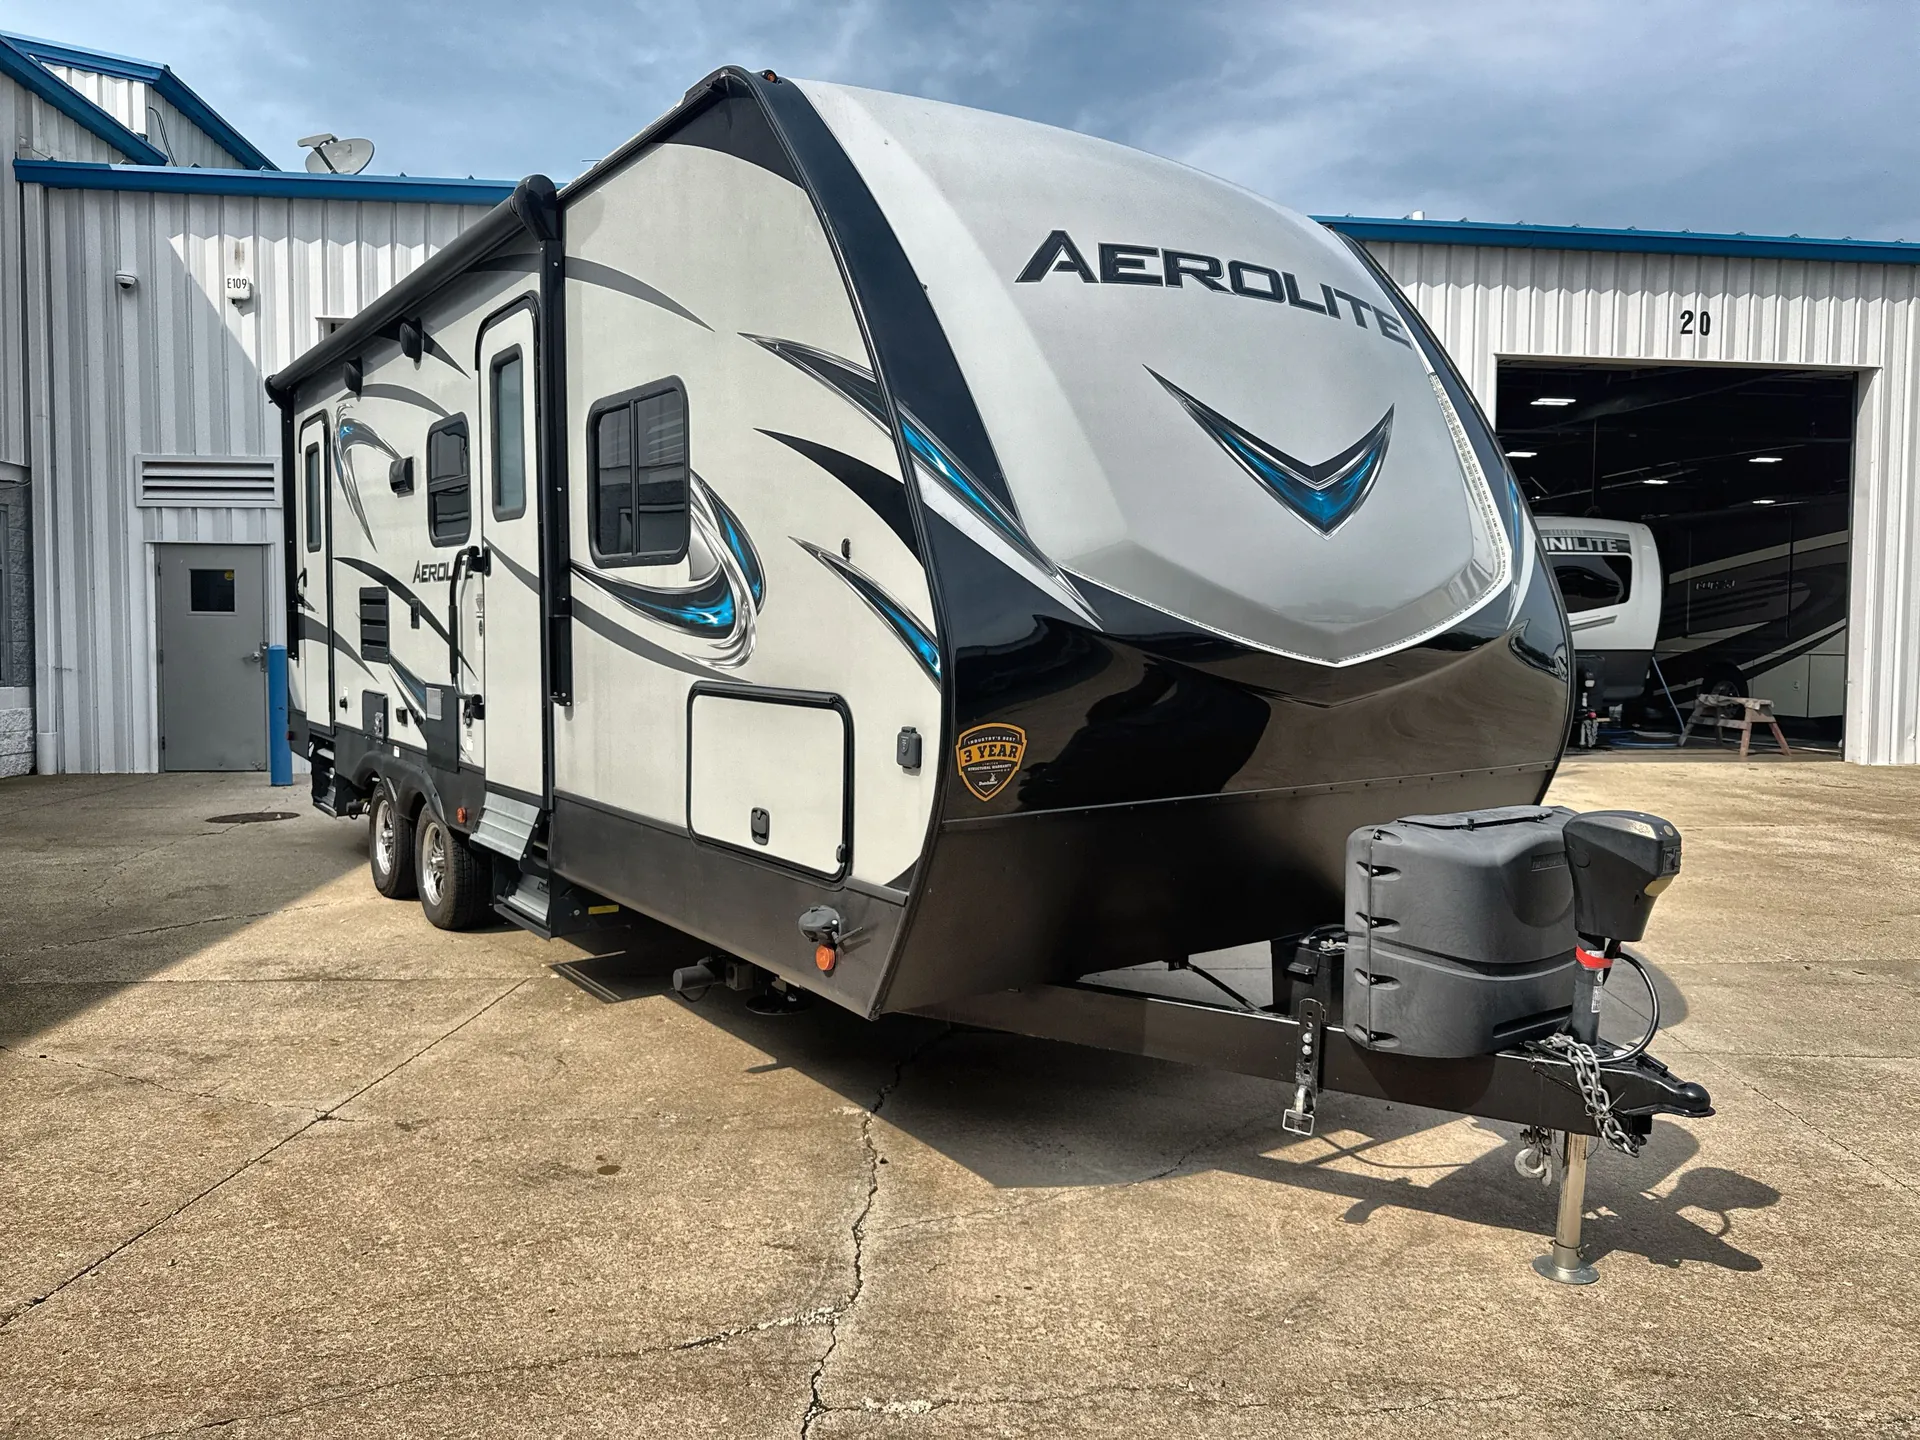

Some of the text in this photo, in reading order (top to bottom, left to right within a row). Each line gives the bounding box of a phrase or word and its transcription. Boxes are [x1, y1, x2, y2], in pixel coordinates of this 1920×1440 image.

[227, 277, 247, 289] E109
[1015, 229, 1412, 349] AEROLITE
[1680, 310, 1711, 336] 20
[1541, 537, 1618, 552] INILITE
[964, 744, 1018, 763] 3 YEAR
